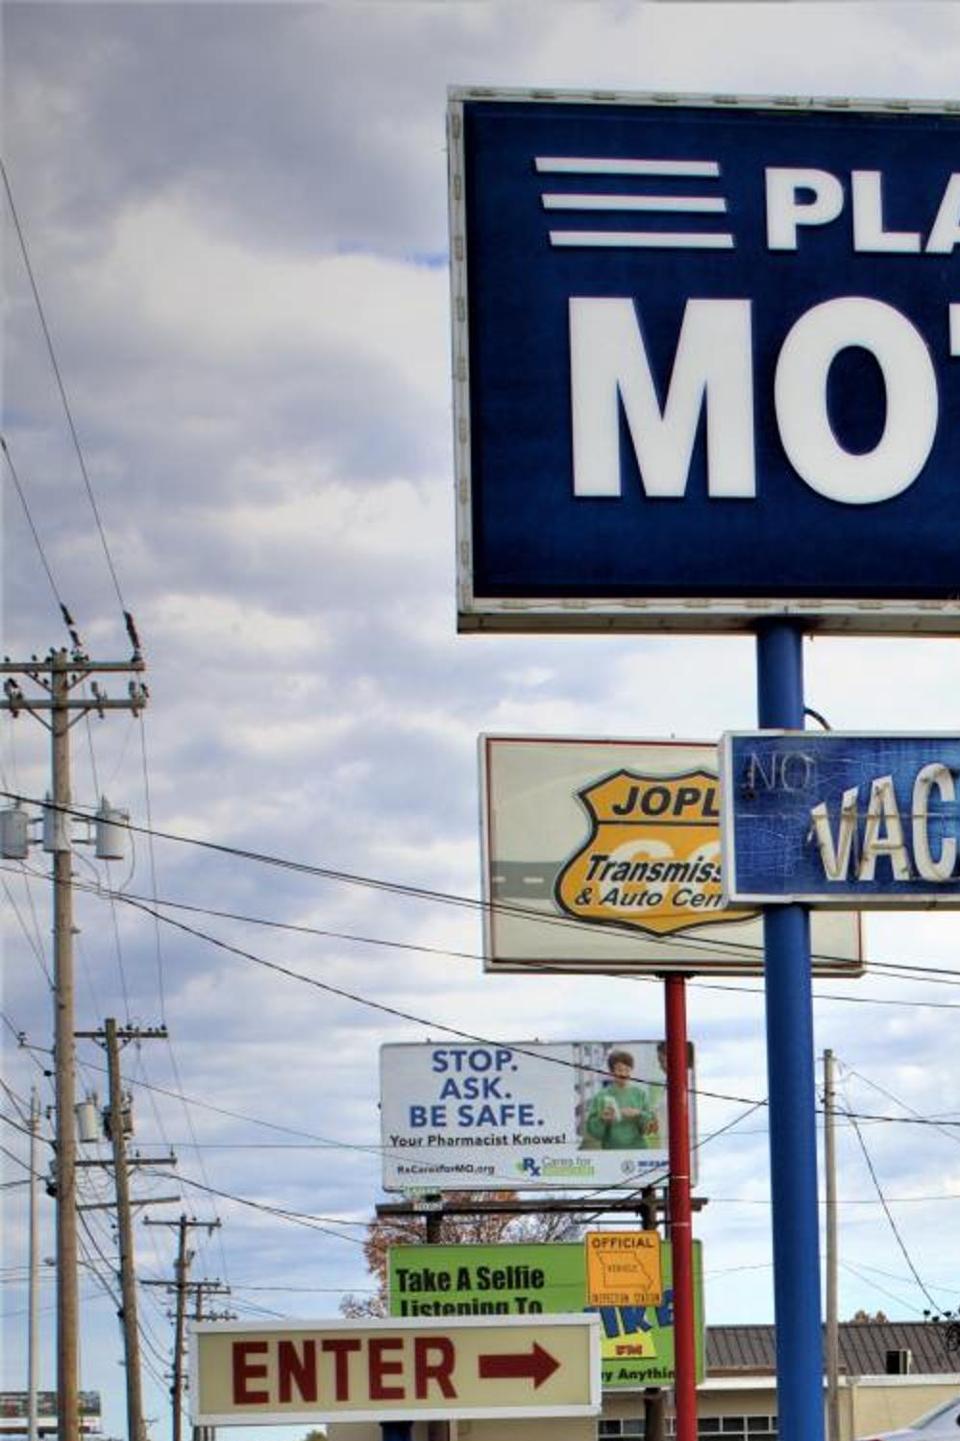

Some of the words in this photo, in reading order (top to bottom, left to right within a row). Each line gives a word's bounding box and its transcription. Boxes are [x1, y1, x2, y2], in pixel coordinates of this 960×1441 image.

[574, 888, 593, 906] &
[599, 887, 663, 907] Auto
[432, 1049, 518, 1073] STOP.
[439, 1077, 512, 1100] ASK.
[409, 1105, 449, 1128] BE
[457, 1103, 544, 1128] SAFE.
[389, 1135, 424, 1147] Your
[427, 1134, 509, 1147] Pharmacist
[512, 1133, 567, 1147] Knows!
[591, 1237, 654, 1249] OFFICIAL
[395, 1267, 451, 1292] Take
[456, 1266, 471, 1291] A
[476, 1265, 545, 1290] Selfie
[515, 1296, 543, 1315] To
[231, 1336, 458, 1405] ENTER
